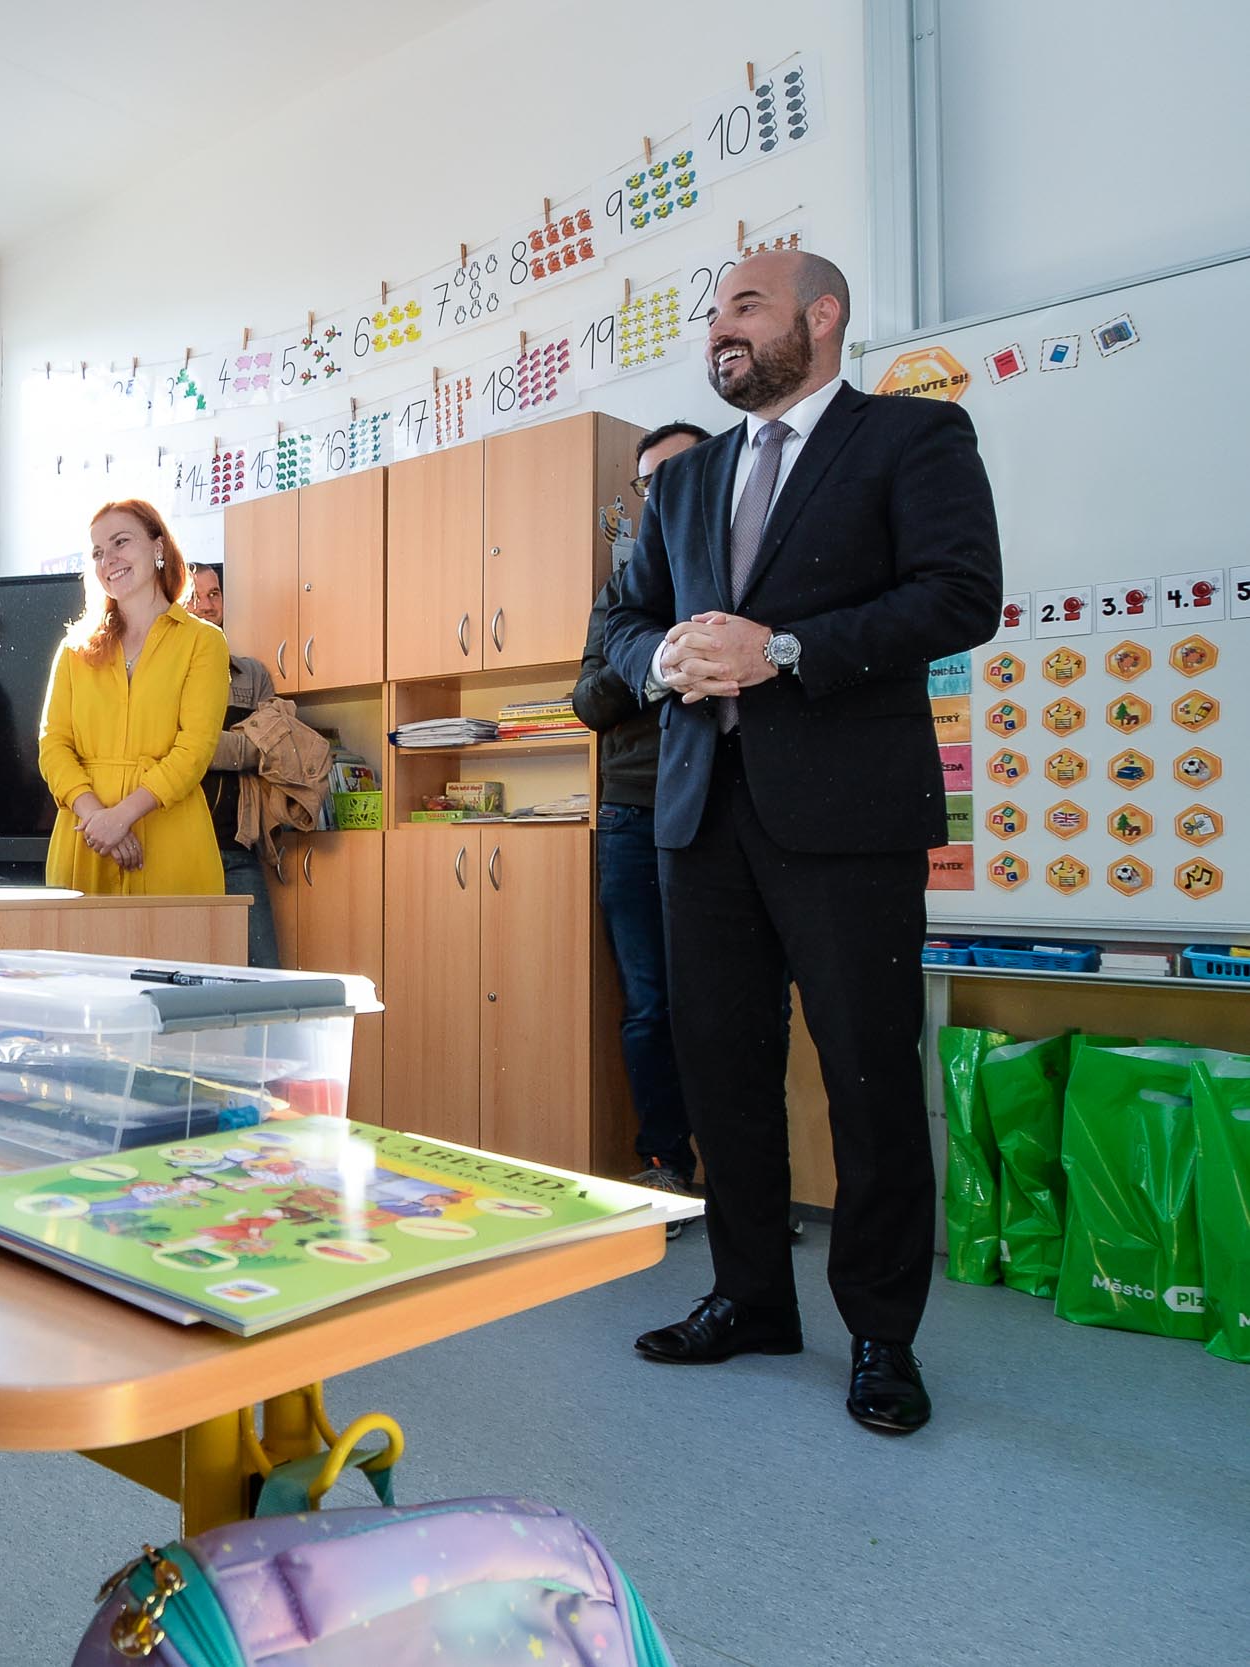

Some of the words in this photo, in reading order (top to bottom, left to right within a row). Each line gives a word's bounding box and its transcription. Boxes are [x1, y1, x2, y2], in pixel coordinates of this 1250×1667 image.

[707, 105, 751, 160] 10
[606, 190, 623, 234] 9
[510, 241, 528, 284] 8
[433, 283, 451, 326] 7
[354, 317, 371, 357] 6
[580, 316, 615, 369] 19
[218, 358, 231, 394] 4
[281, 346, 297, 386] 5
[950, 373, 968, 385] SI!
[482, 366, 516, 415] 18
[399, 399, 430, 446] 17
[250, 448, 275, 490] 15
[320, 430, 346, 472] 16
[186, 464, 208, 502] 14
[1041, 604, 1061, 622] 2.
[1102, 598, 1124, 616] 3.
[1167, 590, 1189, 608] 4.
[929, 664, 966, 677] ONDĚLÍ
[942, 763, 964, 772] EDA
[932, 861, 964, 870] PÁTEK
[1092, 1274, 1155, 1300] Město
